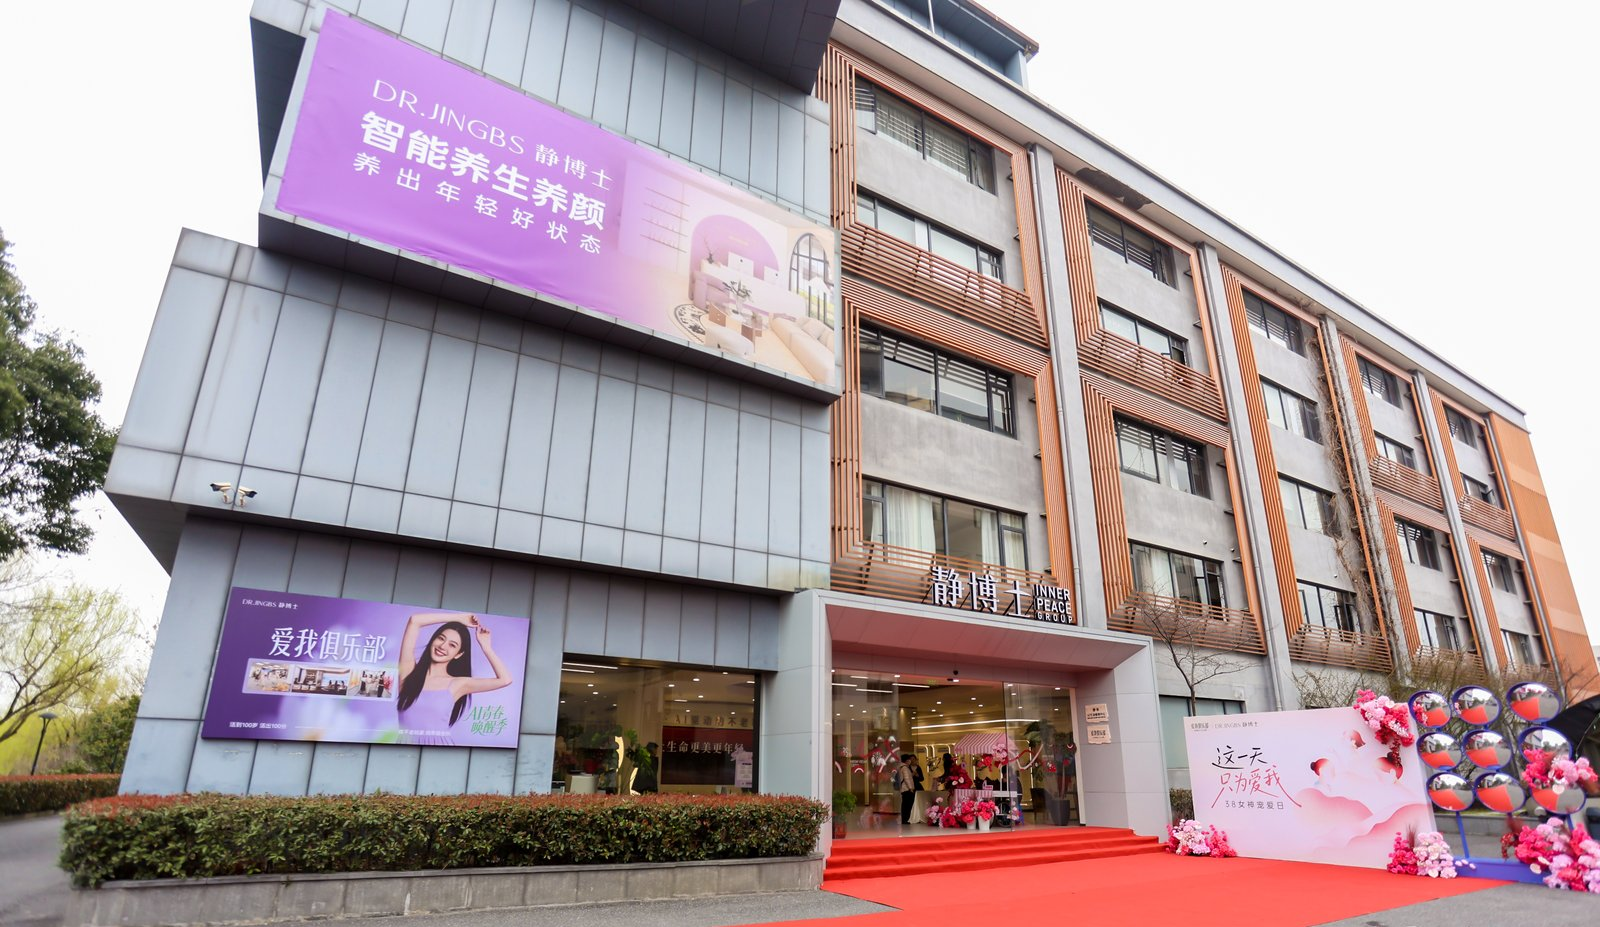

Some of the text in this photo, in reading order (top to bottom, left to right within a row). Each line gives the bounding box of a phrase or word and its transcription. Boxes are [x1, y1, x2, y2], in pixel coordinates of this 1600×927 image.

[372, 79, 615, 191] DR.JINGBS 静博士
[360, 111, 607, 231] 智能养生养颜
[353, 152, 601, 254] 养出年轻好状态
[931, 565, 1031, 618] 静博士
[1035, 584, 1070, 600] INNER
[1037, 599, 1072, 615] PEACE
[1038, 613, 1073, 624] GROUP
[268, 627, 387, 664] 爱我俱乐部
[1211, 745, 1268, 770] 这一天
[1211, 764, 1302, 809] 只为爱我
